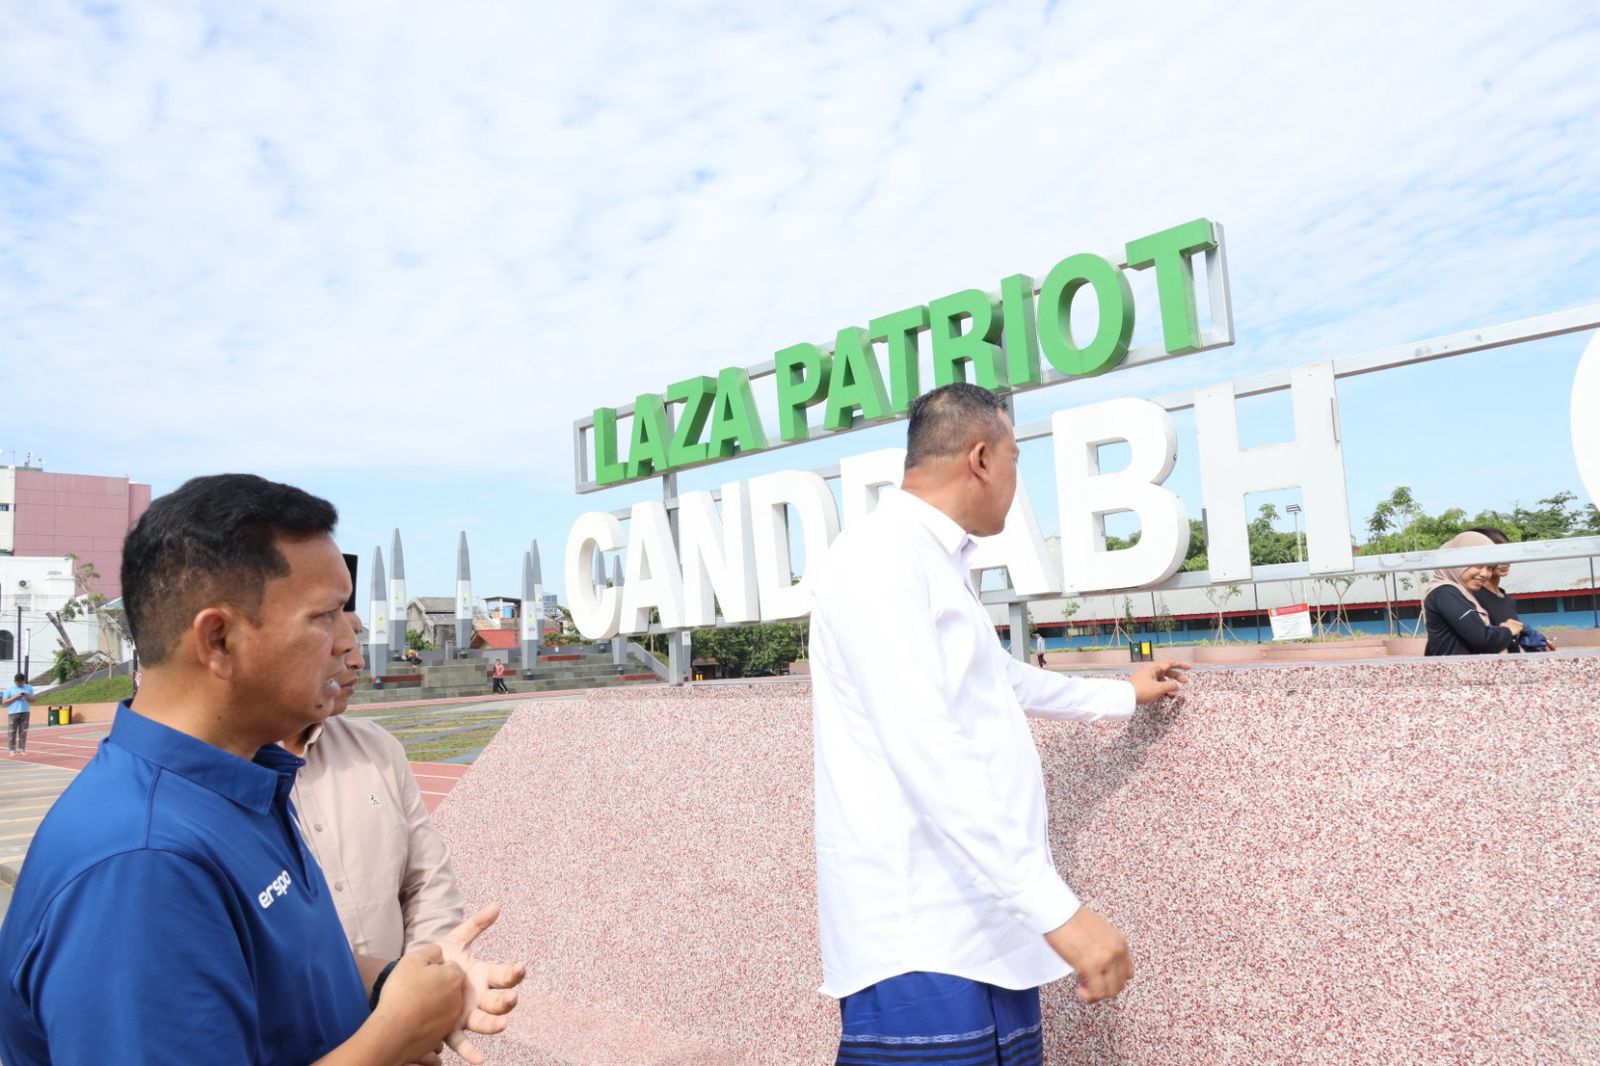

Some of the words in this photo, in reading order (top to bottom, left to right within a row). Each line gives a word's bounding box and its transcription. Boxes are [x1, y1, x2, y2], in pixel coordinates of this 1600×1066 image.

[593, 367, 767, 485] LAZA
[775, 217, 1217, 441] PATRIOT
[258, 870, 292, 909] erspo
